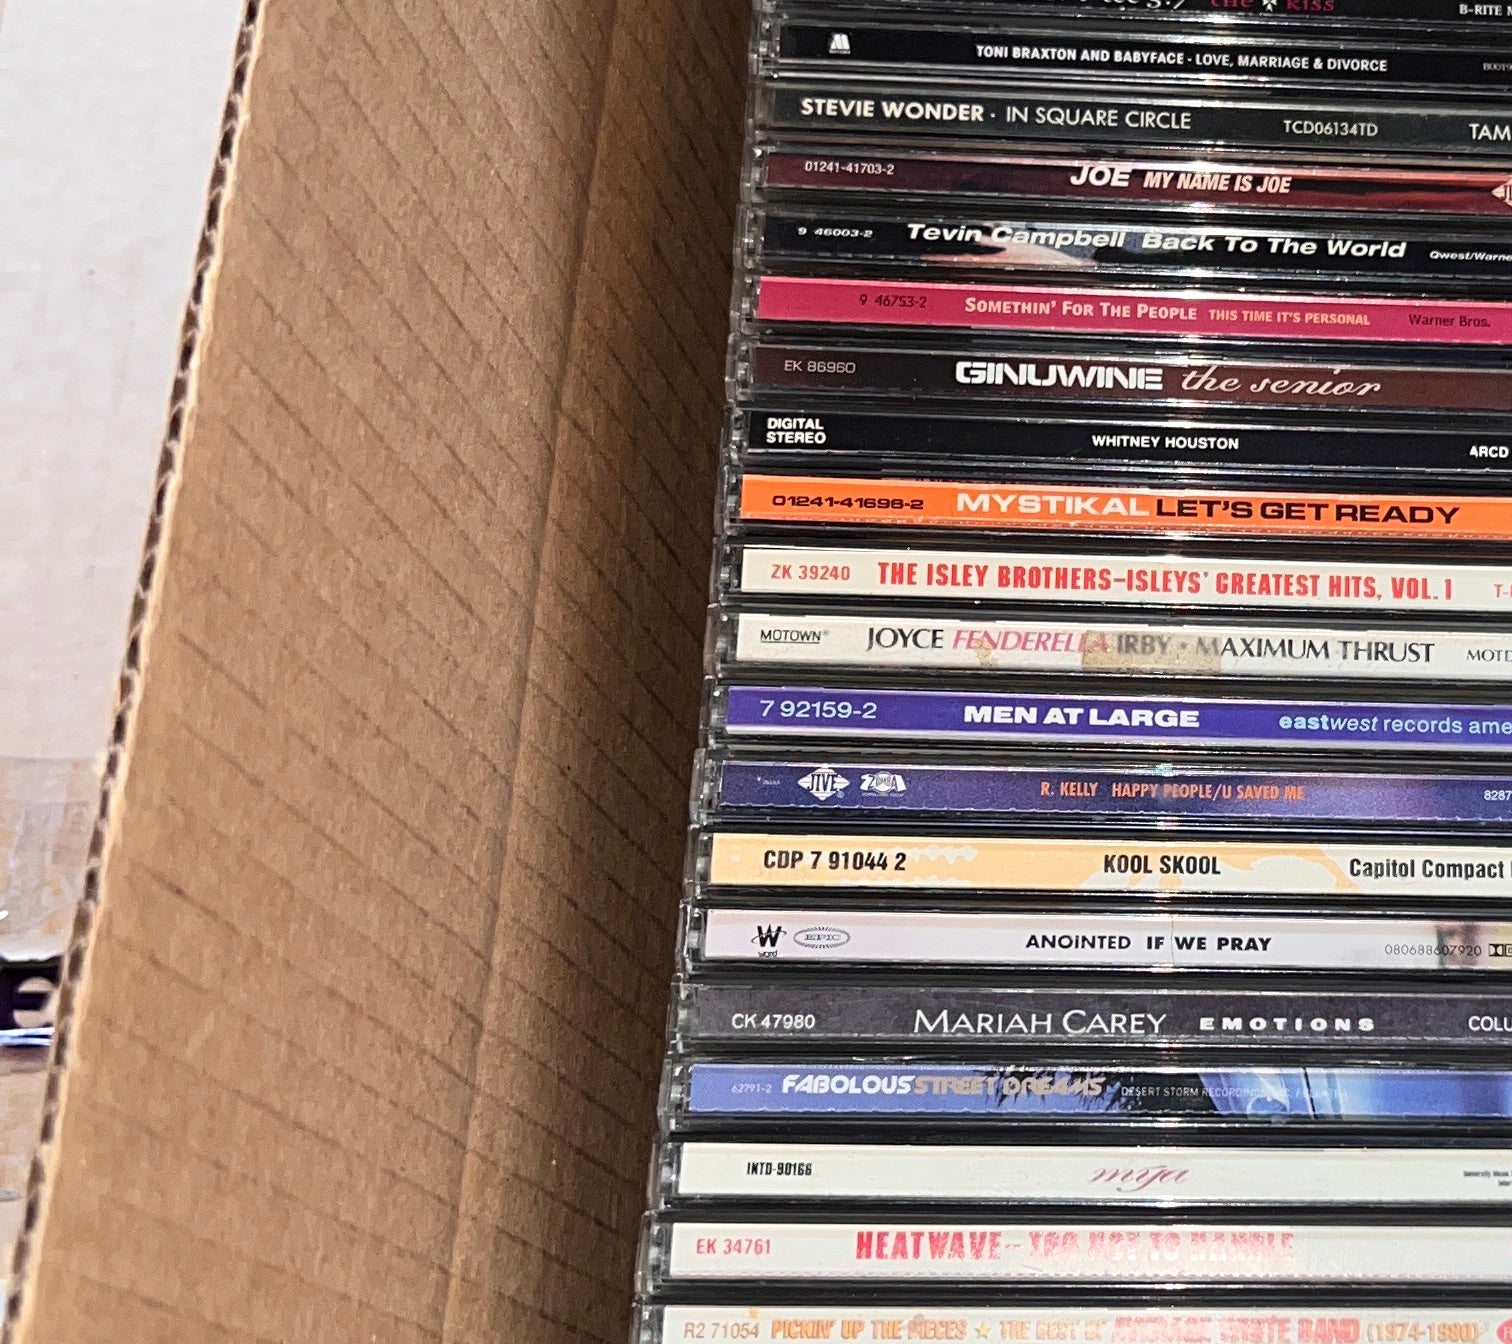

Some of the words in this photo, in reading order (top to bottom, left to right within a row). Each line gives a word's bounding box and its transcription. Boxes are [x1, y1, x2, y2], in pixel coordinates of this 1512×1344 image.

[976, 44, 1008, 58] TONI
[1012, 45, 1076, 60] BRAXTON
[1327, 56, 1388, 71] DIVORCE
[801, 98, 875, 118] STEVIE
[880, 100, 984, 121] WONDER
[1034, 106, 1118, 127] SQUARE
[804, 160, 895, 175] 01241-41703-2
[1069, 166, 1131, 188] JOE
[1178, 173, 1231, 191] NAME
[990, 225, 1126, 249] Campbell
[1141, 233, 1215, 253] Back
[1267, 236, 1318, 255] The
[1326, 239, 1407, 258] World
[1304, 311, 1371, 326] PERSONAL
[1408, 314, 1455, 327] Warner
[807, 360, 856, 374] 86960
[767, 417, 824, 430] DIGITAL
[766, 431, 827, 444] STEREO
[1165, 436, 1239, 450] HOUSTON
[1469, 445, 1509, 458] ARCD
[771, 495, 924, 510] 01241-41698-2
[1260, 502, 1333, 521] GET
[1335, 504, 1460, 524] READY
[798, 565, 850, 581] 39240
[878, 562, 918, 585] THE
[926, 563, 989, 587] ISLEY
[1215, 571, 1320, 598] GREATEST
[866, 628, 944, 651] JOYCE
[1336, 641, 1435, 663] THRUST
[780, 700, 878, 720] 92159-2
[964, 705, 1037, 723] MEN
[1383, 716, 1464, 734] records
[1060, 782, 1098, 797] KELLY
[1112, 783, 1159, 798] HAPPY
[1237, 784, 1279, 801] SAVED
[763, 851, 803, 869] CDP
[828, 851, 888, 870] 91044
[1422, 859, 1504, 881] Compact
[1146, 936, 1165, 951] IF
[1174, 936, 1207, 951] WE
[1217, 937, 1272, 951] PRAY
[763, 1013, 816, 1030] 47980
[1198, 1017, 1377, 1032] EMOTIONS
[781, 1075, 913, 1094] FABOLOUS
[696, 1238, 717, 1254] EK
[723, 1239, 771, 1255] 34761
[683, 1322, 706, 1338] R2
[711, 1322, 760, 1339] 71054
